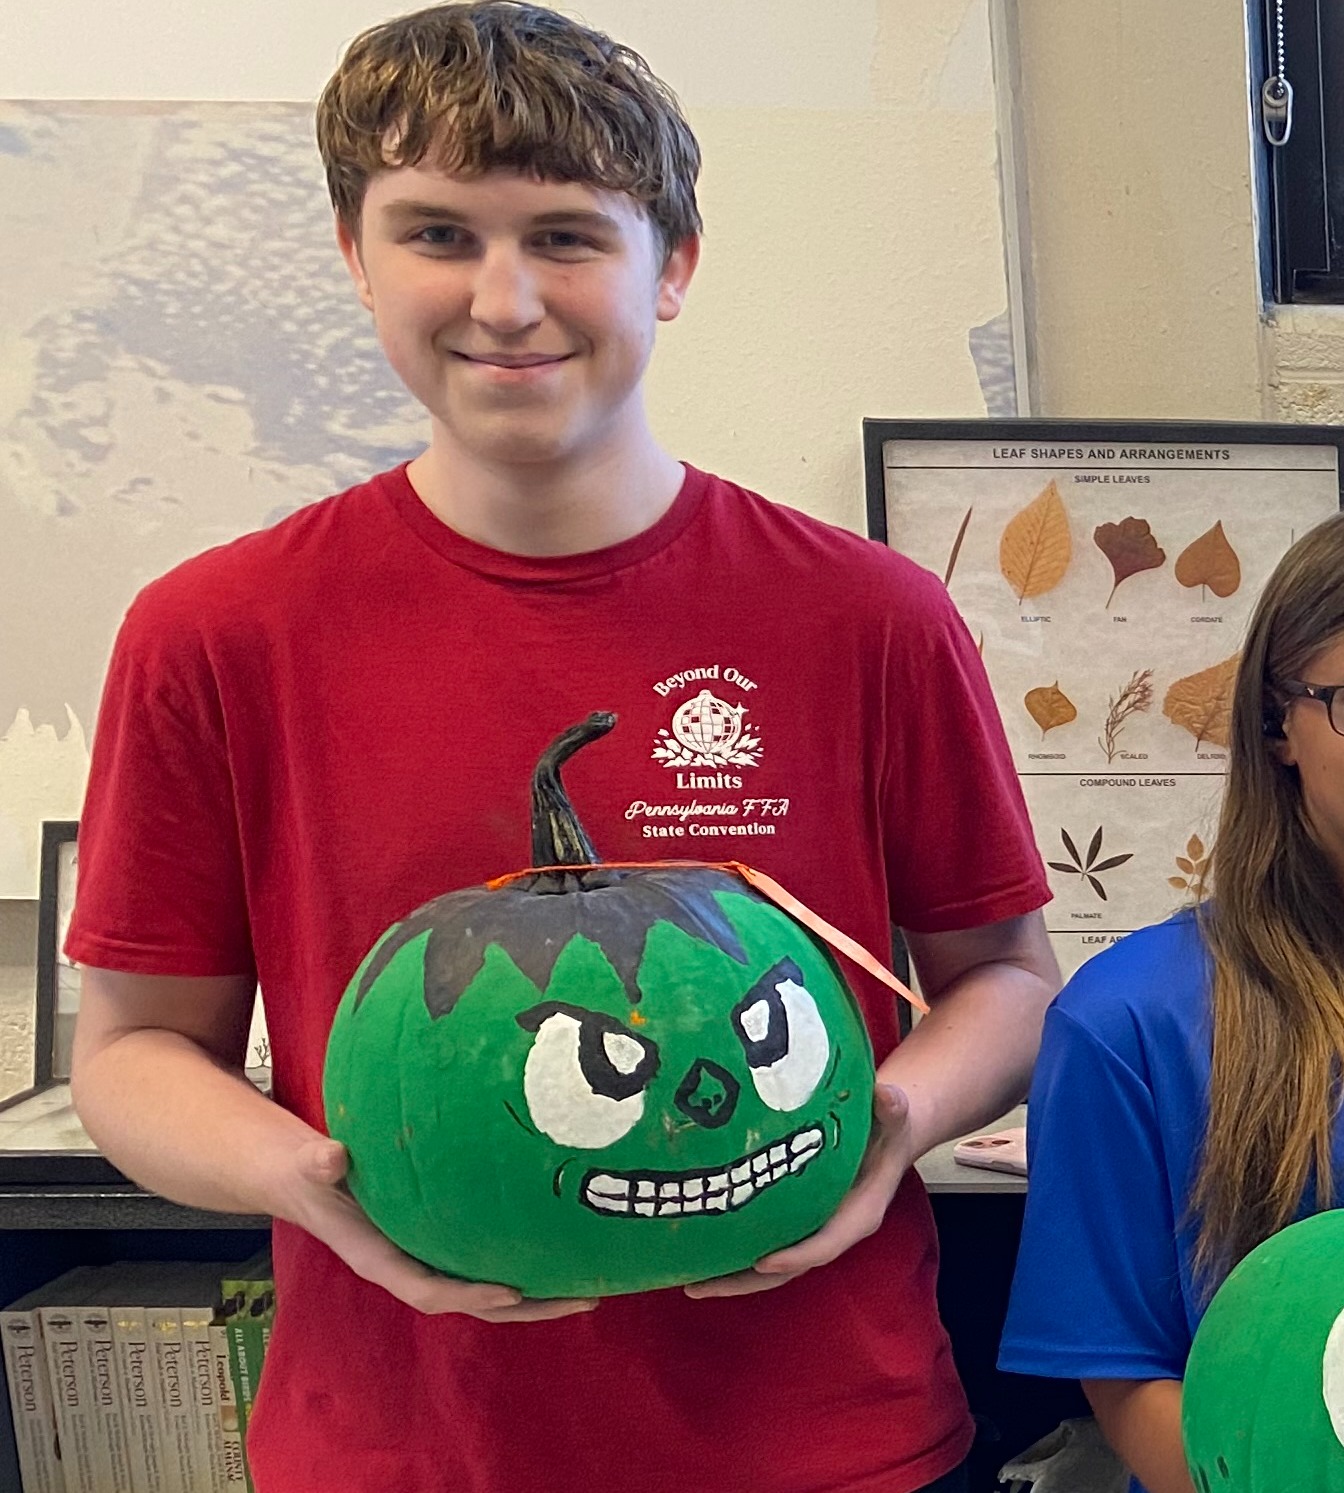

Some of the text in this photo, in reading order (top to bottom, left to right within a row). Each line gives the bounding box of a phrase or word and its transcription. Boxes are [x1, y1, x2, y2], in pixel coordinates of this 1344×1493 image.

[993, 448, 1231, 460] LEAF SHAPES AND ARRANGEMENTS
[1074, 475, 1151, 484] SIMPLE LEAVES
[652, 664, 758, 697] Beyond Our
[676, 772, 743, 789] Limits
[1079, 778, 1176, 787] COMPOUND LEAVES
[624, 799, 739, 822] Pennsylvania
[642, 822, 776, 838] State Convention
[1082, 936, 1106, 944] LEAF
[234, 1327, 244, 1343] ALL
[58, 1340, 80, 1408] Peterson
[94, 1340, 113, 1407] Peterson
[128, 1342, 149, 1408] Peterson
[163, 1342, 183, 1408] Peterson
[194, 1340, 213, 1407] Peterson
[237, 1344, 249, 1375] ABOUT
[17, 1345, 37, 1412] Peterson
[216, 1354, 231, 1402] Leopold
